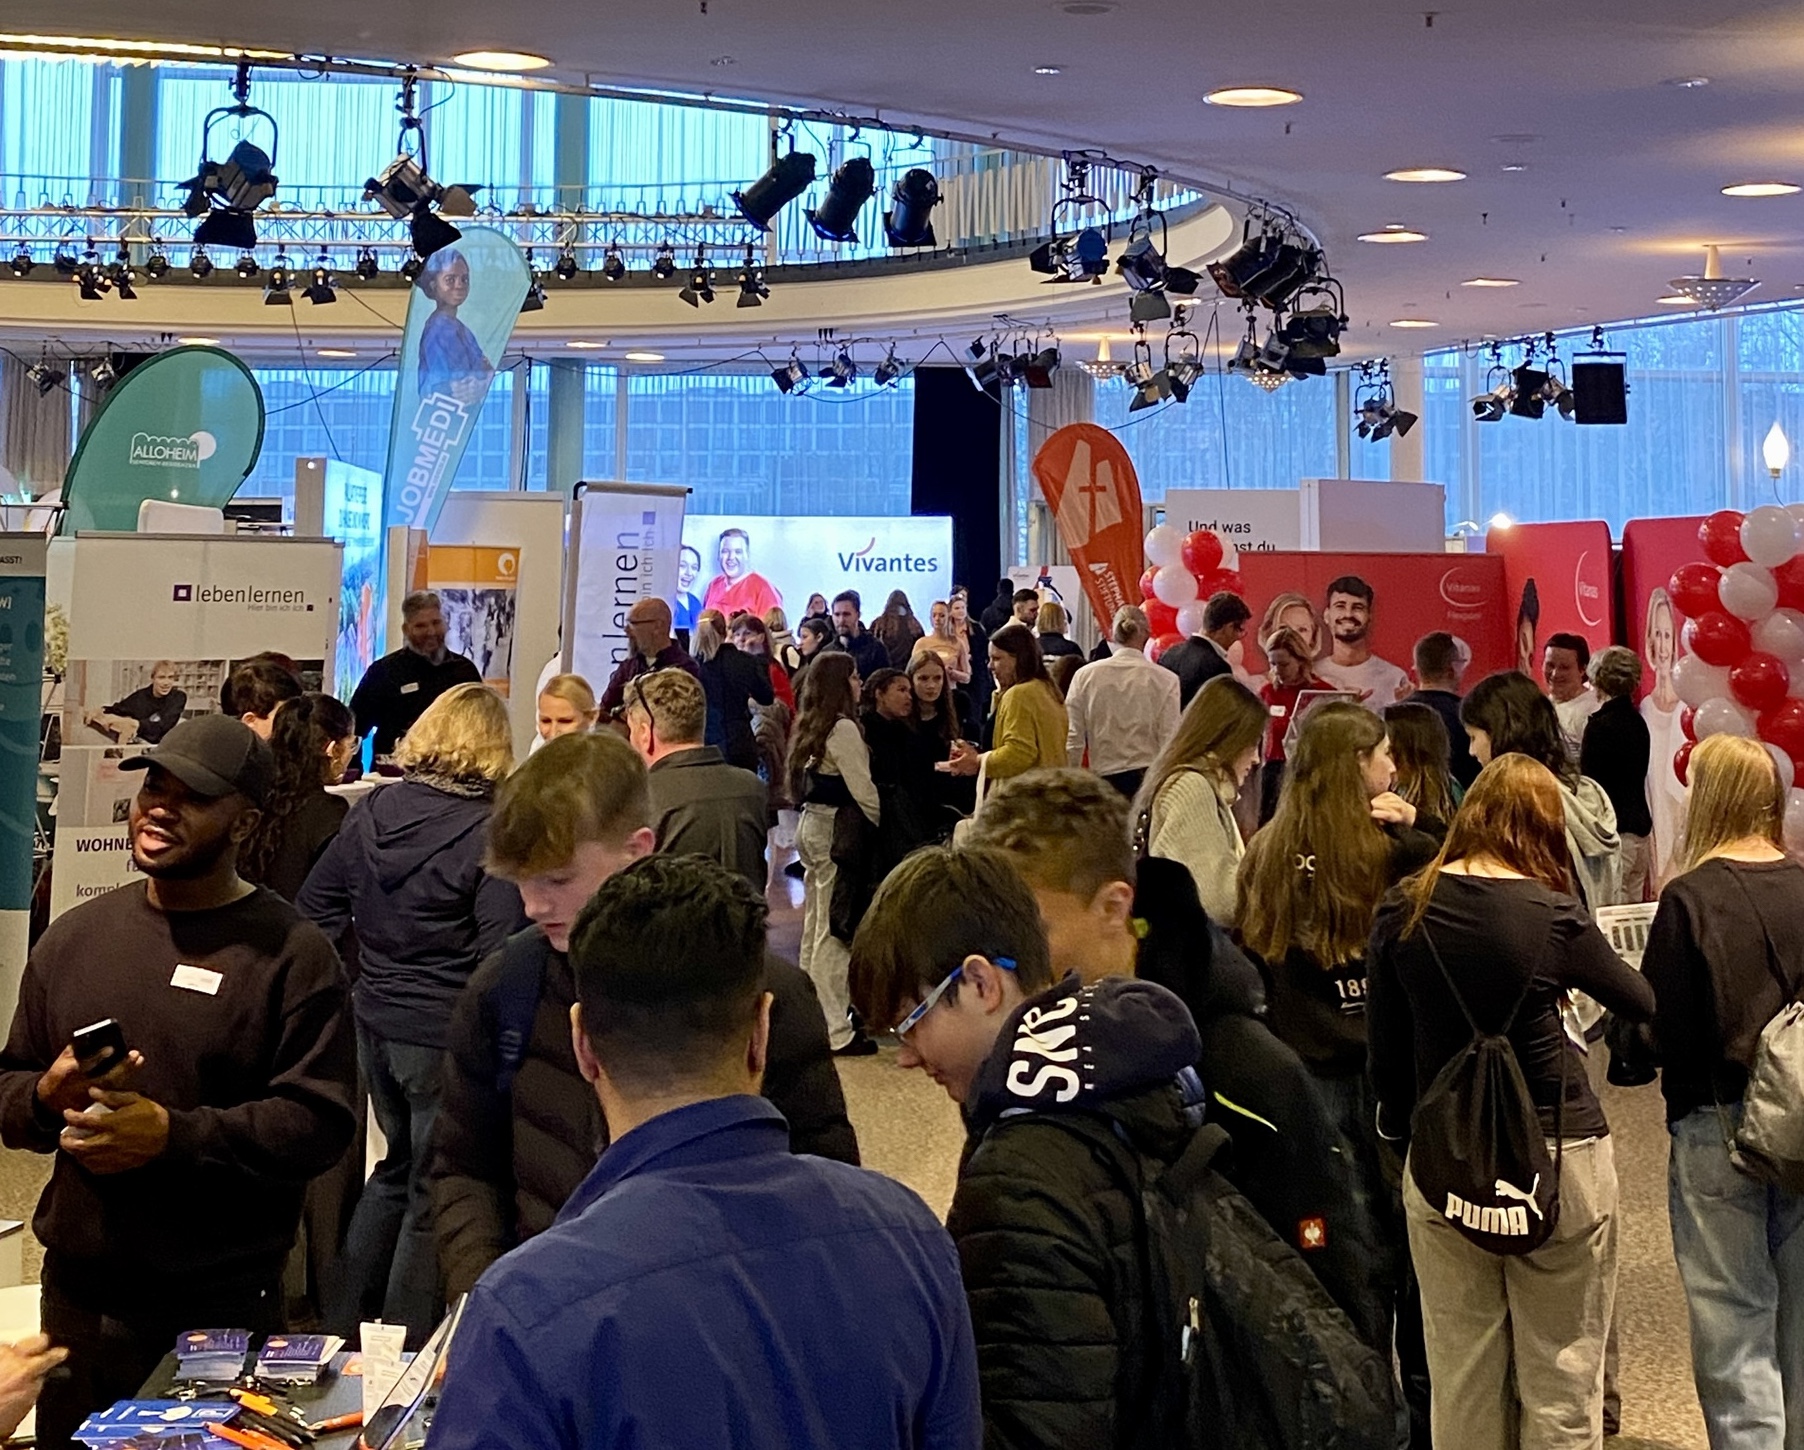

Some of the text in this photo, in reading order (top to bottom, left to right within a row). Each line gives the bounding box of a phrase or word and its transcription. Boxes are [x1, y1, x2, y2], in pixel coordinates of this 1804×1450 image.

[133, 445, 197, 461] ALLOHEIM
[396, 401, 456, 523] JOBMEDI
[1222, 523, 1251, 533] was
[838, 549, 938, 572] Vivantes
[1445, 1191, 1529, 1236] PUMA
